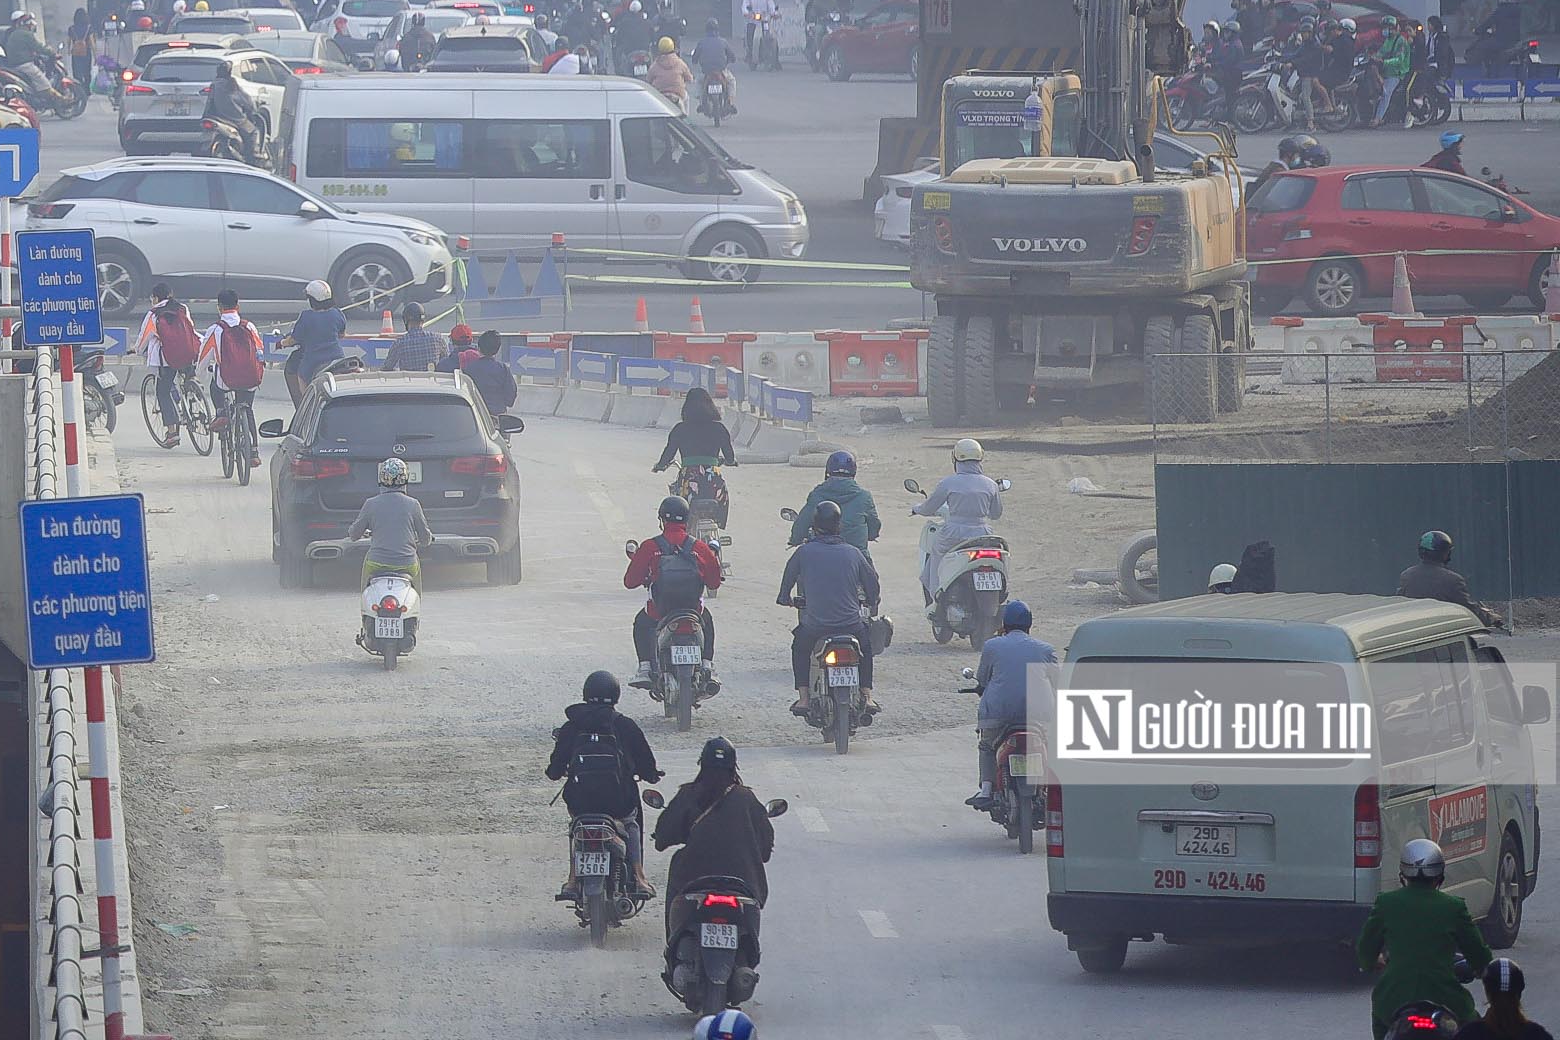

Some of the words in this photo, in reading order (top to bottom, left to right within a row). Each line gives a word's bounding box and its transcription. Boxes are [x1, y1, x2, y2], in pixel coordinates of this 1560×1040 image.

[972, 89, 1015, 98] VOLVO
[28, 245, 47, 260] Làn
[50, 244, 82, 261] đường
[992, 237, 1088, 252] VOLVO
[38, 271, 61, 286] dành
[64, 271, 82, 285] cho
[24, 298, 41, 312] các
[42, 298, 76, 315] phương
[77, 297, 95, 312] tiện
[40, 324, 63, 340] quay
[66, 318, 85, 336] đầu
[41, 517, 69, 538] Làn
[73, 514, 121, 539] đường
[53, 554, 90, 576] dành
[93, 553, 121, 574] cho
[33, 595, 59, 616] các
[61, 593, 117, 620] phương
[119, 590, 146, 613] tiện
[55, 633, 90, 656] quay
[95, 624, 122, 649] đầu
[1444, 793, 1484, 829] LALAMOVE
[1193, 827, 1219, 840] 29D
[1183, 841, 1230, 854] 424.46
[580, 863, 605, 874] 2506
[1154, 869, 1186, 889] 29D
[1208, 871, 1265, 892] 424.46
